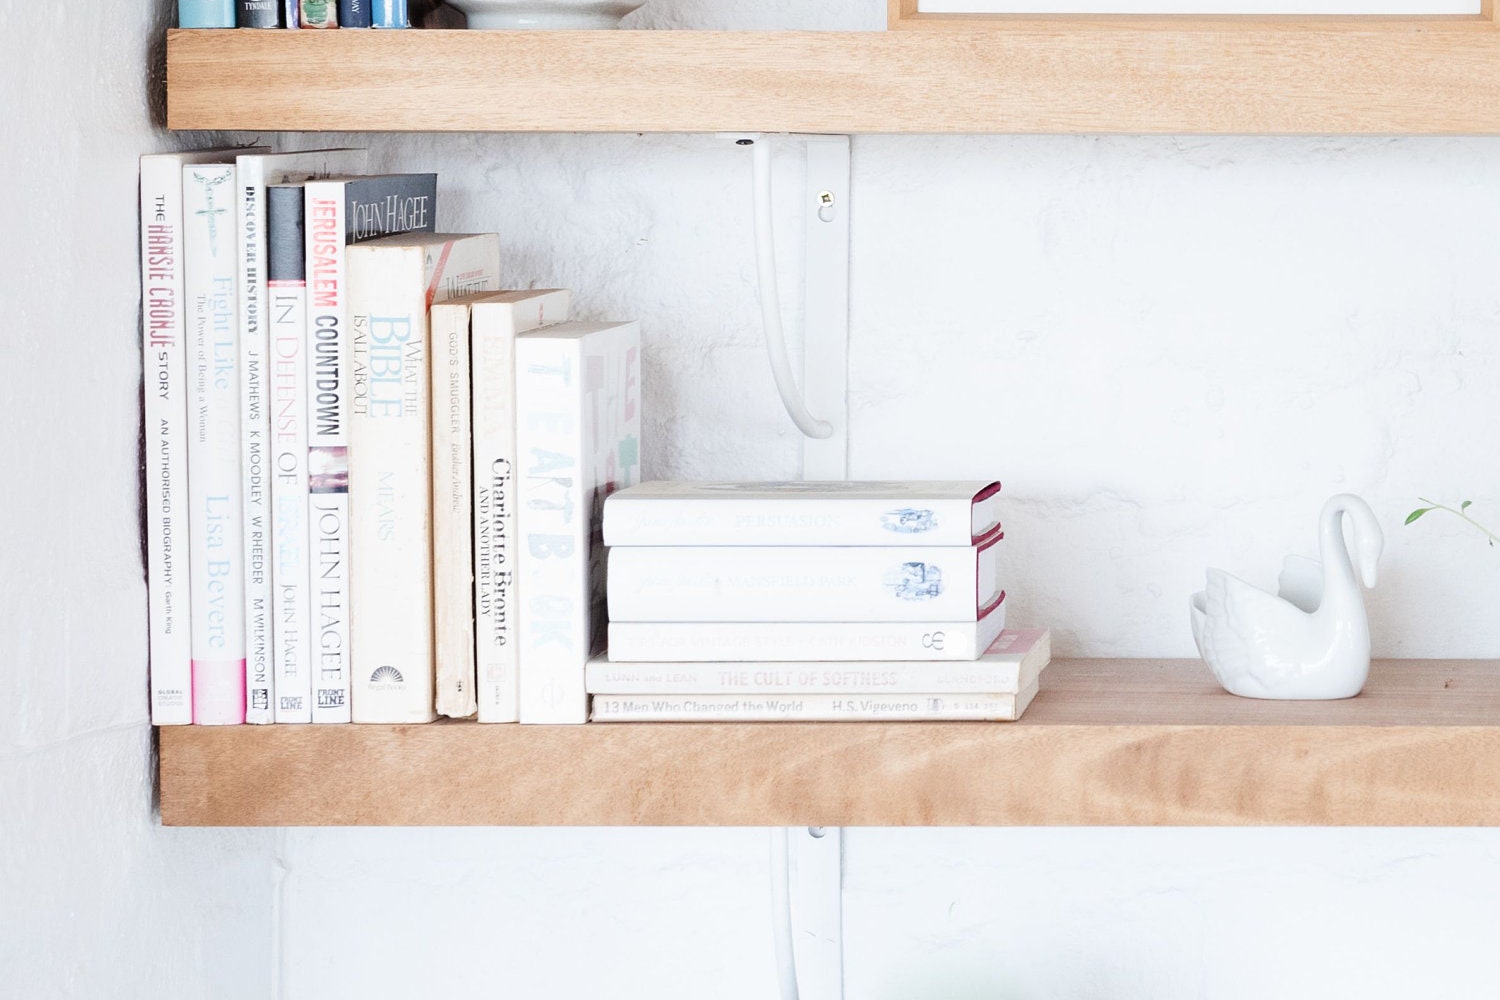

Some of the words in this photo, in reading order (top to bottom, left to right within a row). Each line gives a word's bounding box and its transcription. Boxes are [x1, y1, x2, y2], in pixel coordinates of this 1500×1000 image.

[244, 2, 272, 10] TYNDALE
[155, 194, 166, 222] THE
[245, 186, 257, 263] DISCOVER
[352, 201, 384, 244] JOHN
[384, 194, 429, 234] HAGEE
[147, 224, 174, 280] HANSIE
[312, 196, 338, 307] JERUSALEM
[149, 287, 175, 348] CRONJE
[196, 294, 207, 313] The
[208, 275, 233, 332] Fight
[247, 267, 259, 336] HISTORY
[275, 295, 298, 324] IN
[197, 316, 207, 348] Power
[197, 350, 208, 361] of
[449, 332, 460, 366] GOD'S
[158, 351, 170, 401] STORY
[196, 365, 208, 393] Being
[213, 340, 234, 390] Like
[315, 315, 340, 436] COUNTDOWN
[369, 312, 412, 419] BIBLE
[405, 339, 422, 387] WHAT
[249, 360, 261, 420] MATHEWS
[404, 391, 418, 418] THE
[449, 371, 461, 434] SMUGGLER
[160, 419, 170, 436] AN
[199, 405, 209, 443] Woman
[161, 439, 172, 514] AUTHORISED
[250, 442, 262, 505] MOODLEY
[277, 451, 299, 486] OF
[206, 494, 230, 549] Lisa
[251, 515, 262, 527] W
[375, 471, 395, 542] MEARS
[479, 485, 491, 515] AND
[162, 516, 173, 589] BIOGRAPHY:
[252, 531, 264, 585] RHEEDER
[315, 504, 341, 580] JOHN
[480, 516, 491, 579] ANOTHER
[165, 591, 173, 614] Garth
[207, 560, 231, 648] Bevere
[253, 598, 265, 610] M
[480, 581, 492, 618] LADY
[164, 615, 174, 635] King
[253, 613, 266, 683] WILKINSON
[320, 590, 342, 681] HAGEE
[318, 696, 344, 704] LINE
[717, 671, 743, 686] THE
[753, 671, 792, 686] CULT
[797, 671, 819, 686] OF
[823, 671, 898, 686] SOFTNESS
[603, 701, 619, 714] 13
[622, 700, 650, 713] Men
[651, 700, 681, 713] Who
[682, 700, 740, 716] Changed
[741, 700, 765, 713] the
[765, 700, 804, 713] World
[831, 700, 858, 712] H.S.
[859, 700, 920, 715] Vigeveno
